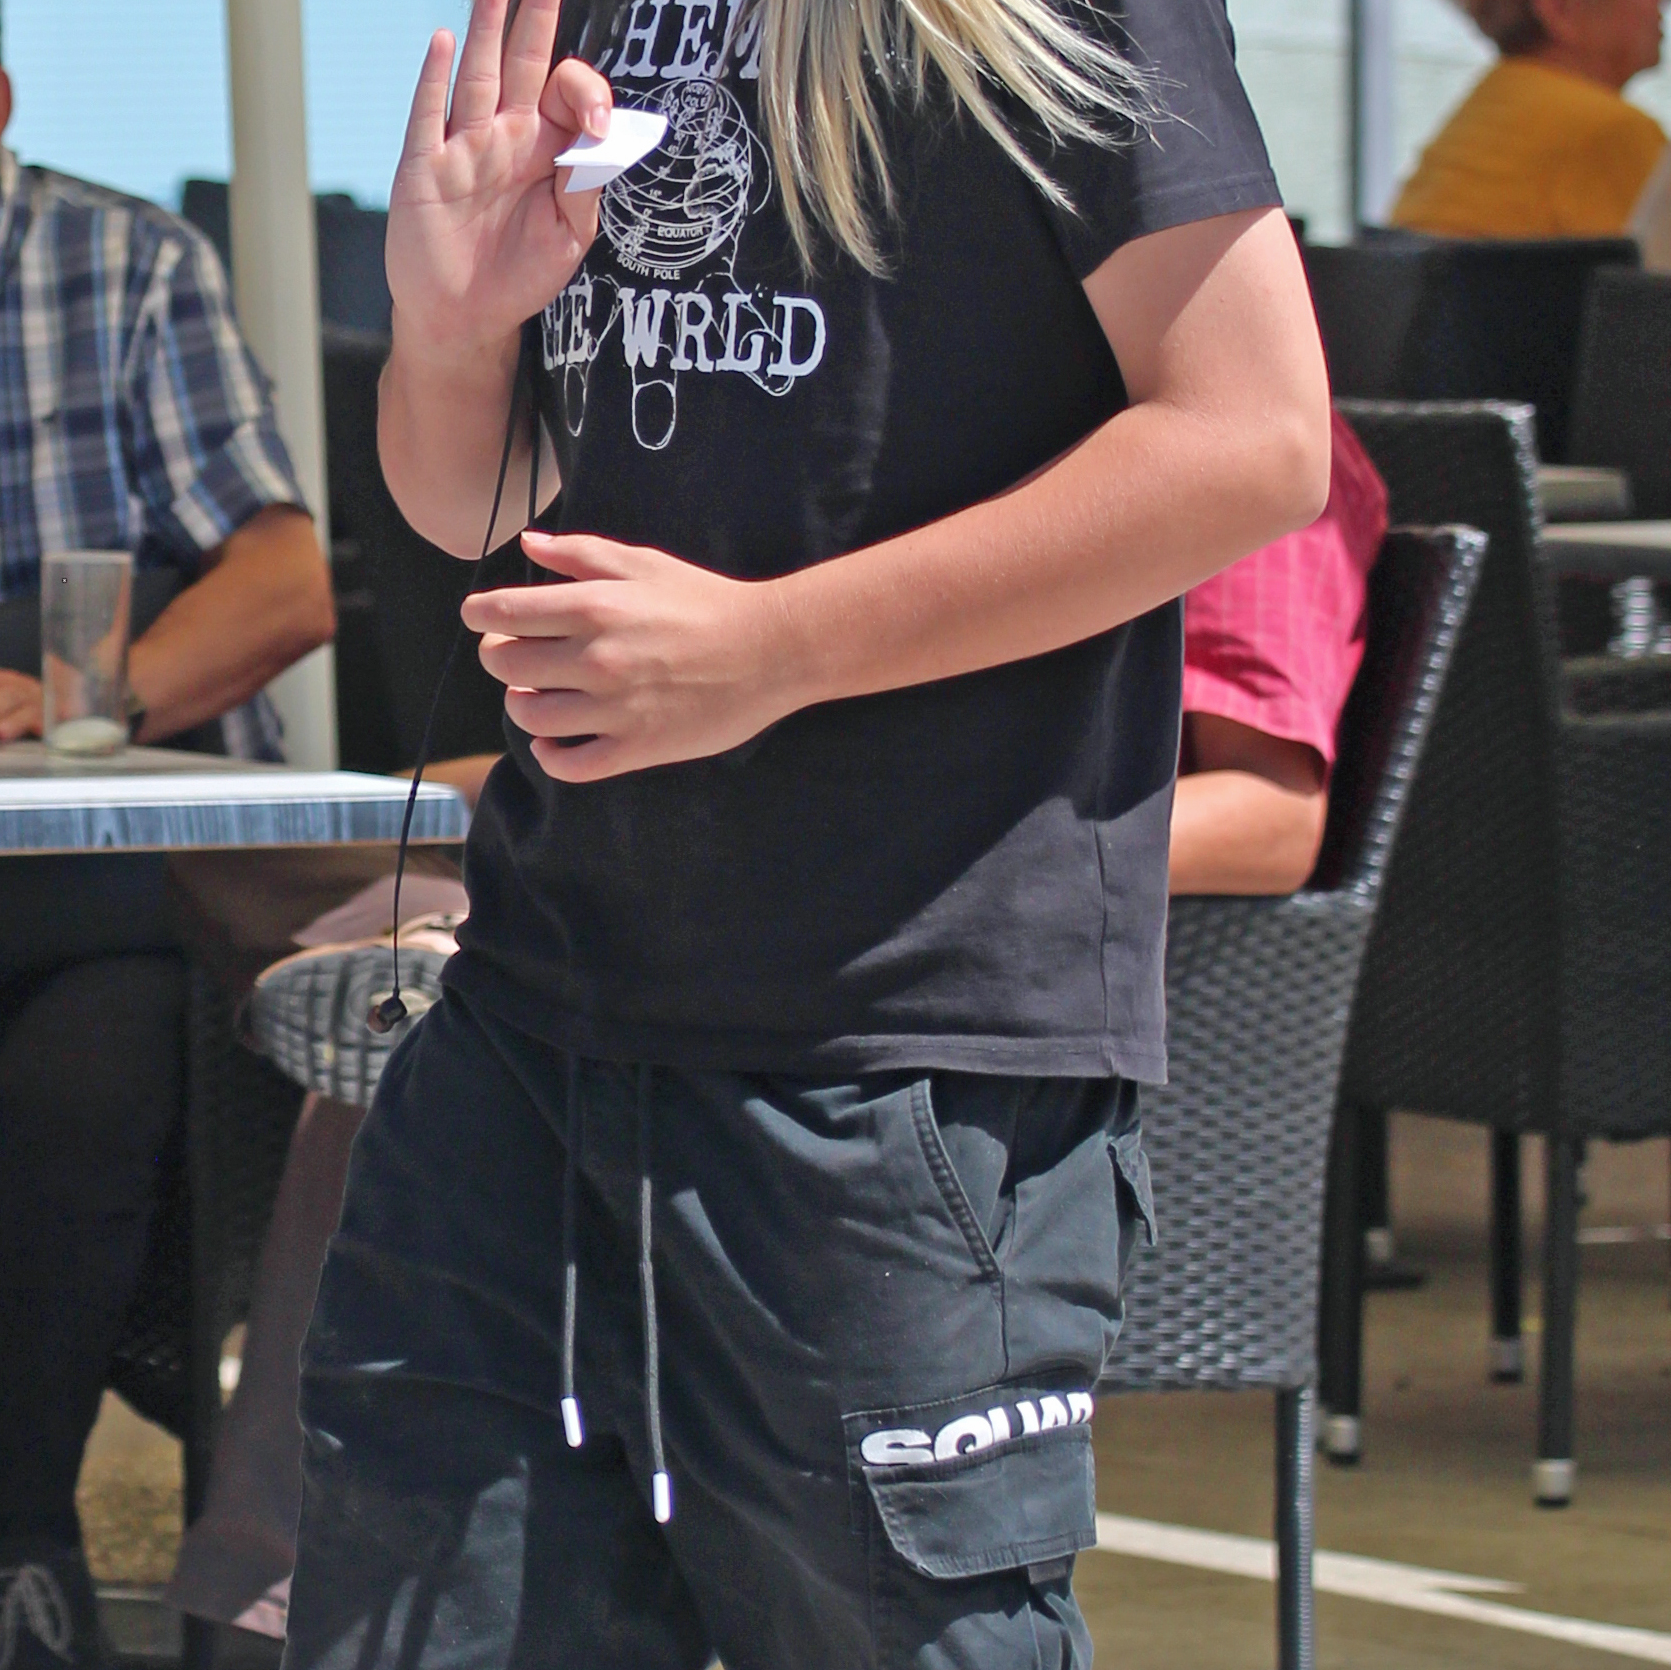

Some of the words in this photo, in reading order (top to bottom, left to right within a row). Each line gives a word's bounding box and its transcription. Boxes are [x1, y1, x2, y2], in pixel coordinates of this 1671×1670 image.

[616, 252, 651, 276] SOUTH
[653, 268, 681, 281] POLE
[617, 288, 826, 377] WRLD
